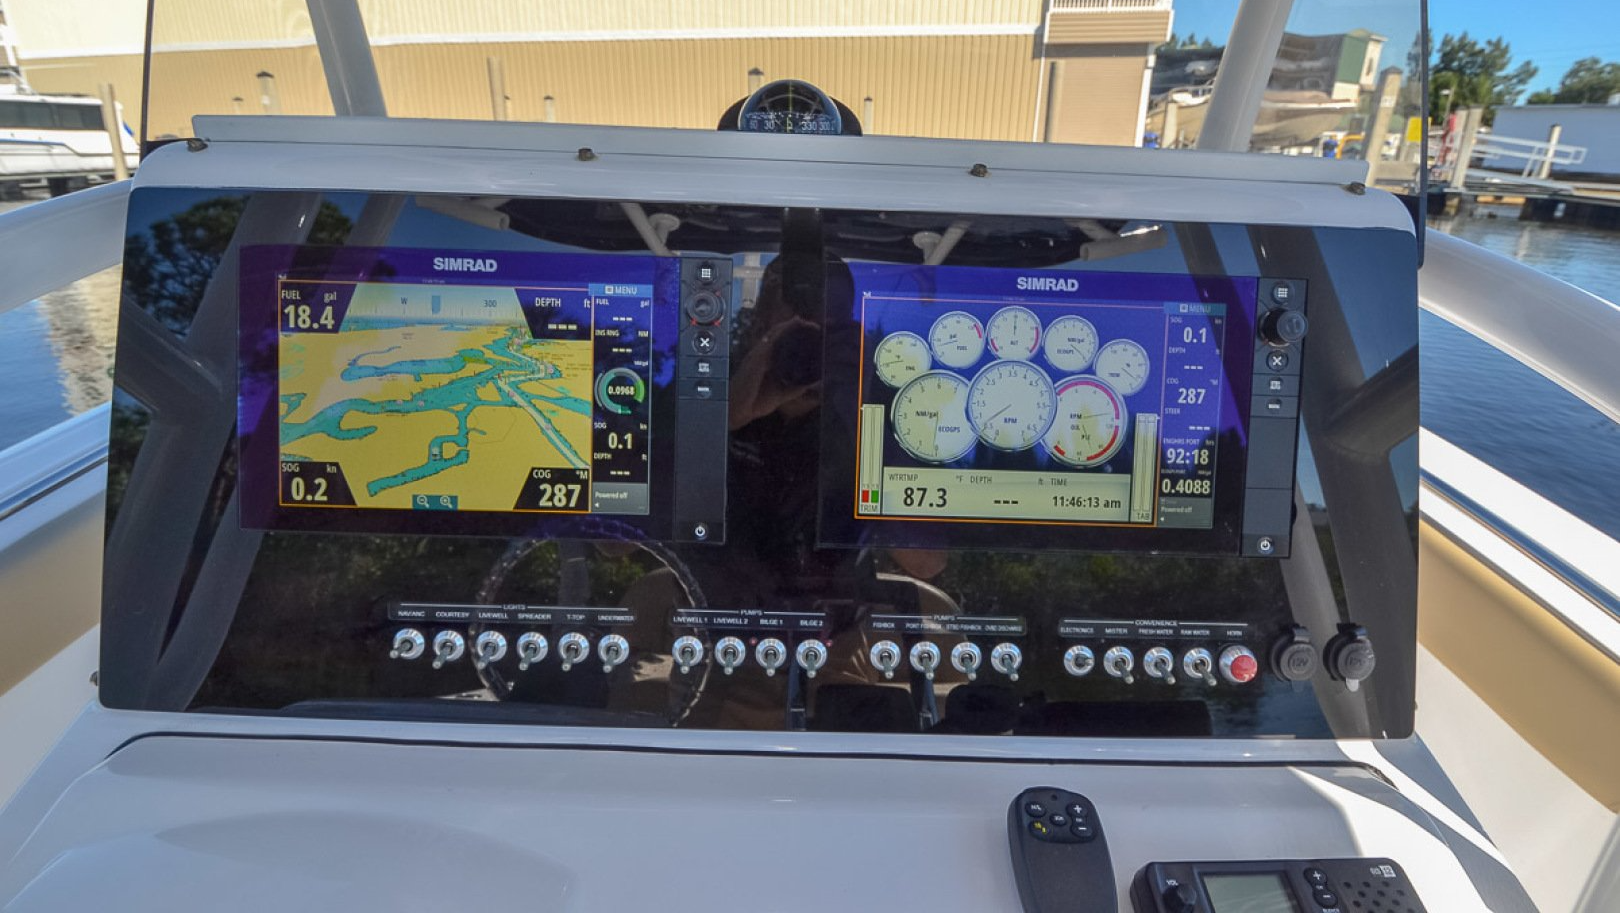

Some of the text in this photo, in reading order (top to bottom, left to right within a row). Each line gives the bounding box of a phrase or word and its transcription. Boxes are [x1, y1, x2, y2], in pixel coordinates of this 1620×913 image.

[433, 257, 497, 272] SIMRAD
[615, 286, 637, 295] MENU
[1016, 277, 1079, 292] SIMRAD
[281, 290, 337, 303] FUEL gal
[401, 297, 408, 305] W
[535, 297, 591, 308] DEPTH ft
[484, 300, 497, 308] 300
[284, 305, 335, 329] 18.4
[1183, 327, 1207, 343] 0.1
[608, 386, 635, 395] 0.0968
[1177, 388, 1206, 404] 287
[608, 432, 633, 449] 0.1
[1167, 448, 1209, 465] 92:18
[281, 463, 337, 473] SOG kn
[533, 469, 551, 479] COG
[889, 473, 918, 481] WTRTMP
[970, 476, 993, 484] DEPTH
[1050, 478, 1067, 486] TIME
[291, 477, 328, 501] 0.2
[1162, 479, 1211, 494] 0.4088
[539, 484, 581, 508] 287
[595, 491, 628, 499] Powered off
[903, 487, 947, 508] 87.3
[861, 504, 878, 512] TRIM
[1052, 496, 1121, 509] 11:46:13 am
